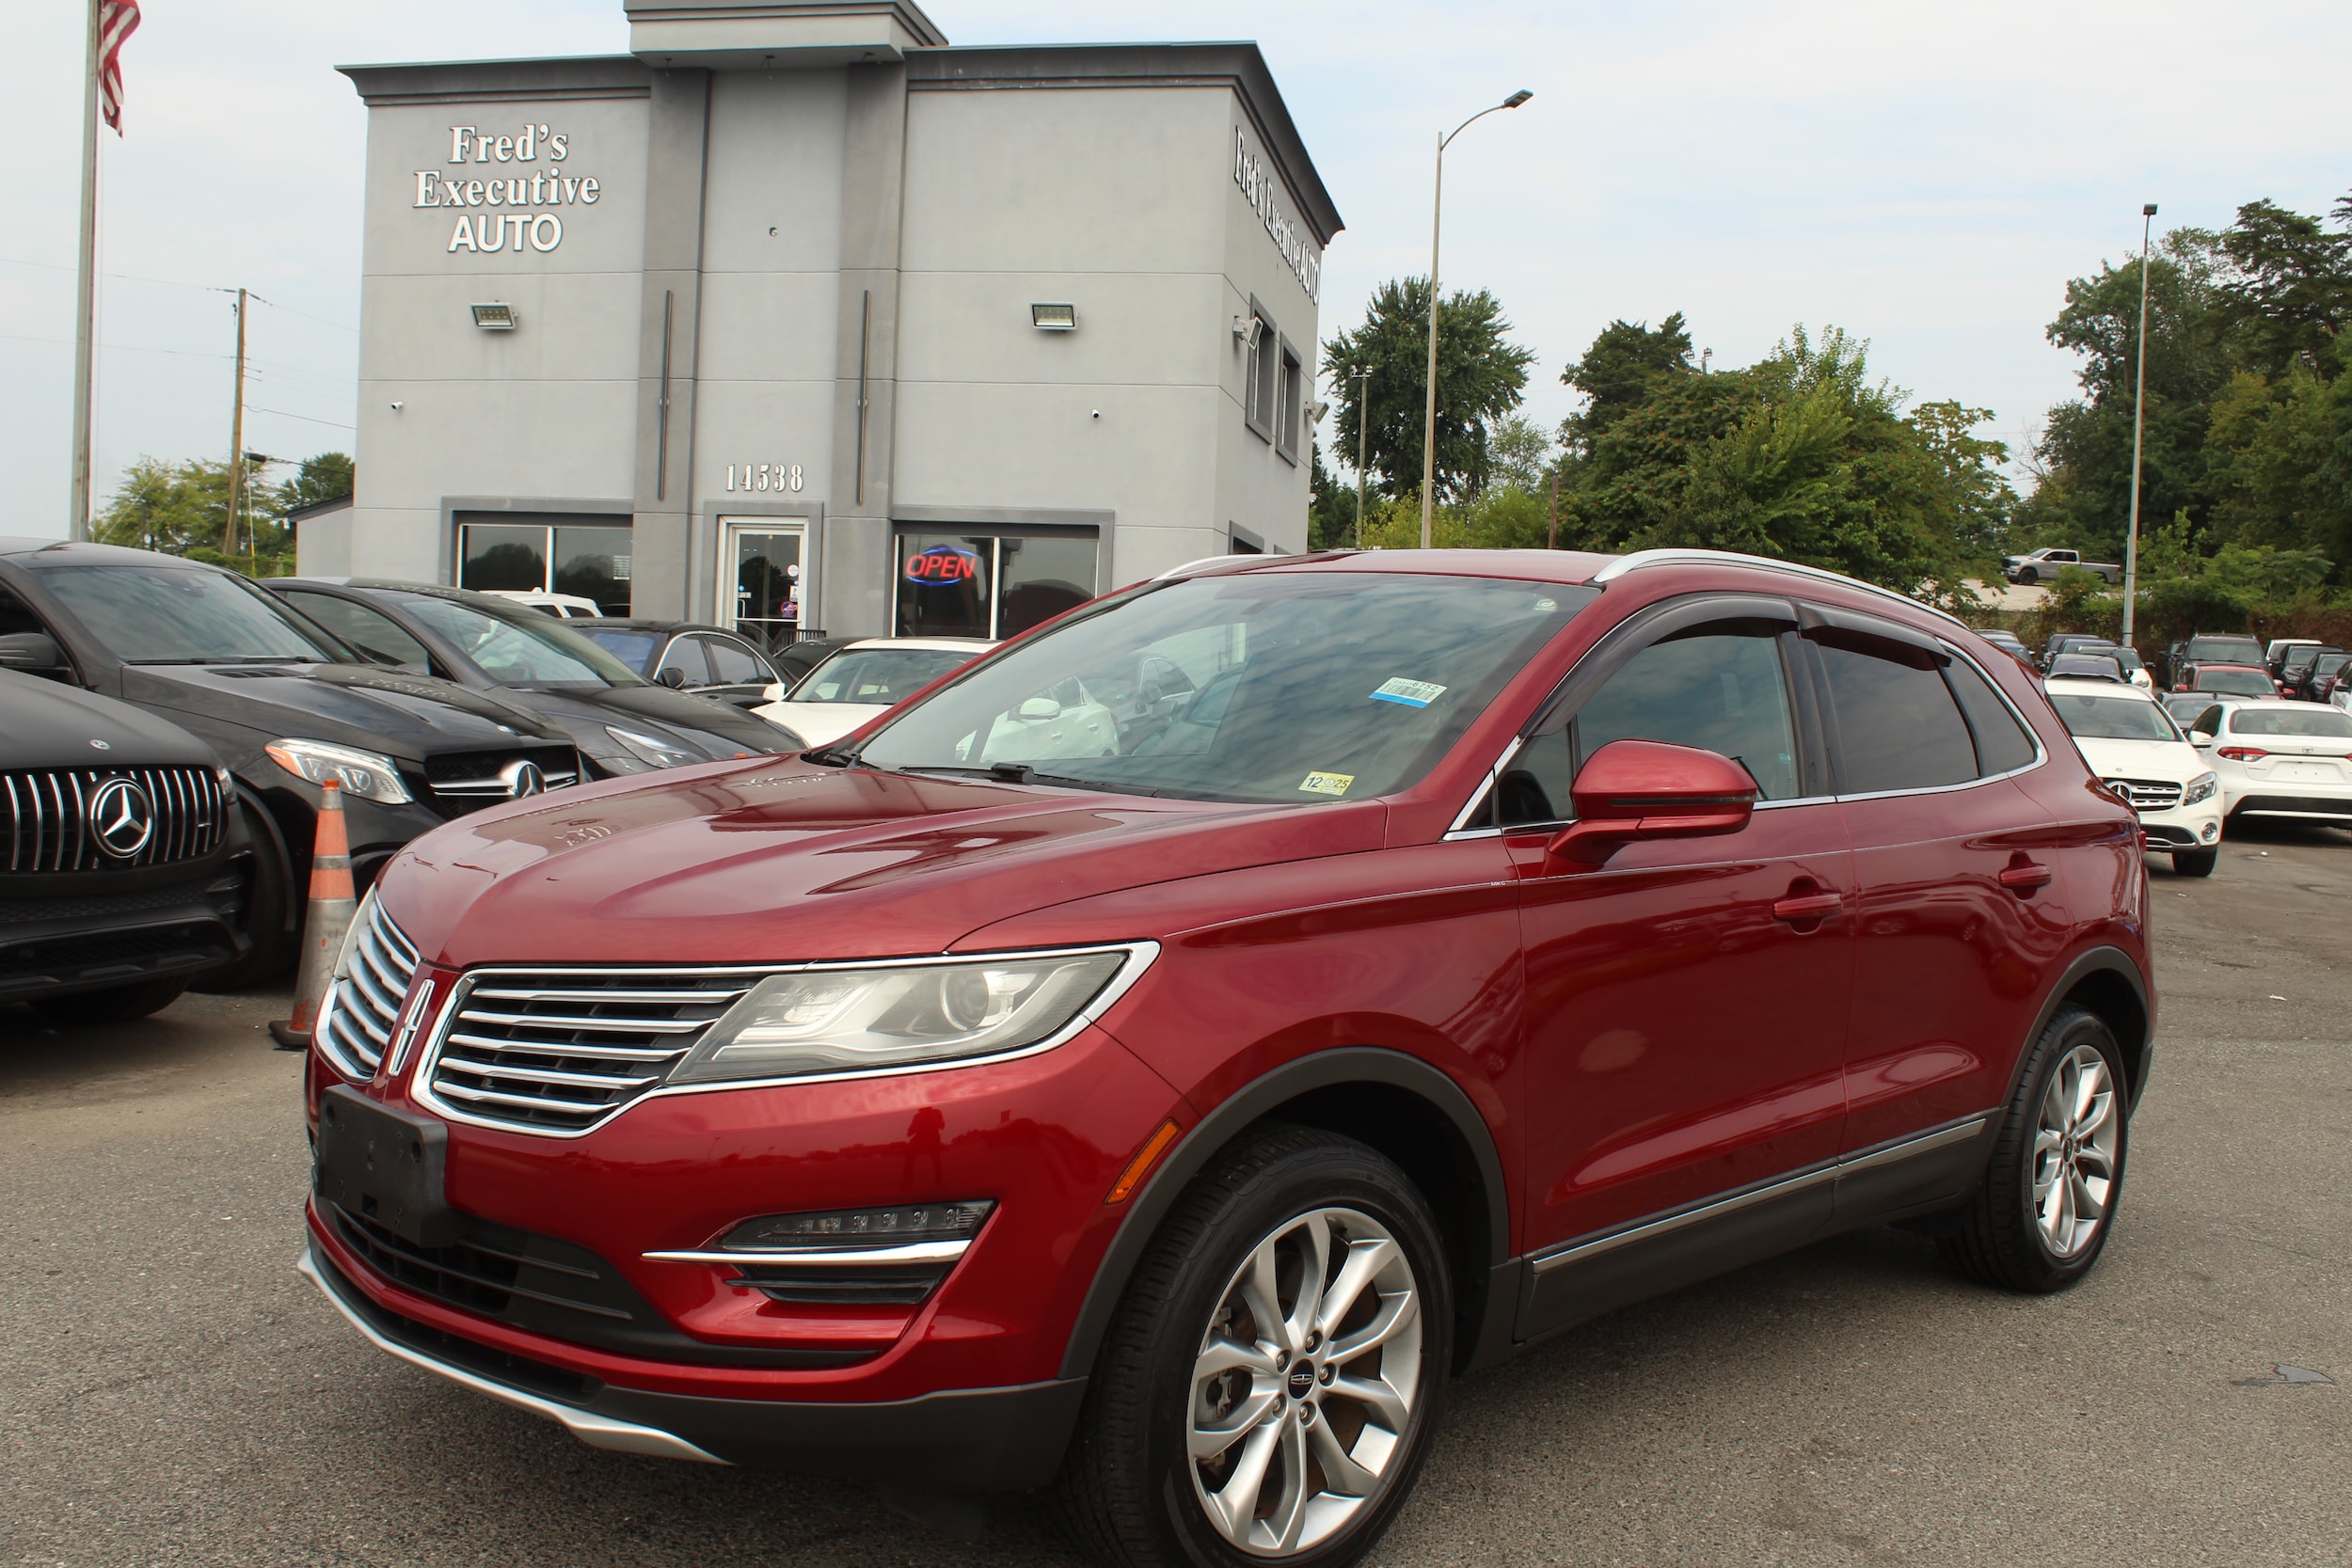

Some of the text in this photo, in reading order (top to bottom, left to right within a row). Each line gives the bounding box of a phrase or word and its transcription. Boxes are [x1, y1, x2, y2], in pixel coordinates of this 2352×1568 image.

[448, 123, 568, 164] Fred's
[413, 166, 600, 208] Executive
[447, 213, 564, 253] AUTO
[1234, 125, 1319, 306] Fred's Executive AUTO
[725, 463, 804, 492] 14538
[905, 554, 977, 578] OPEN
[1307, 776, 1349, 788] 12 25
